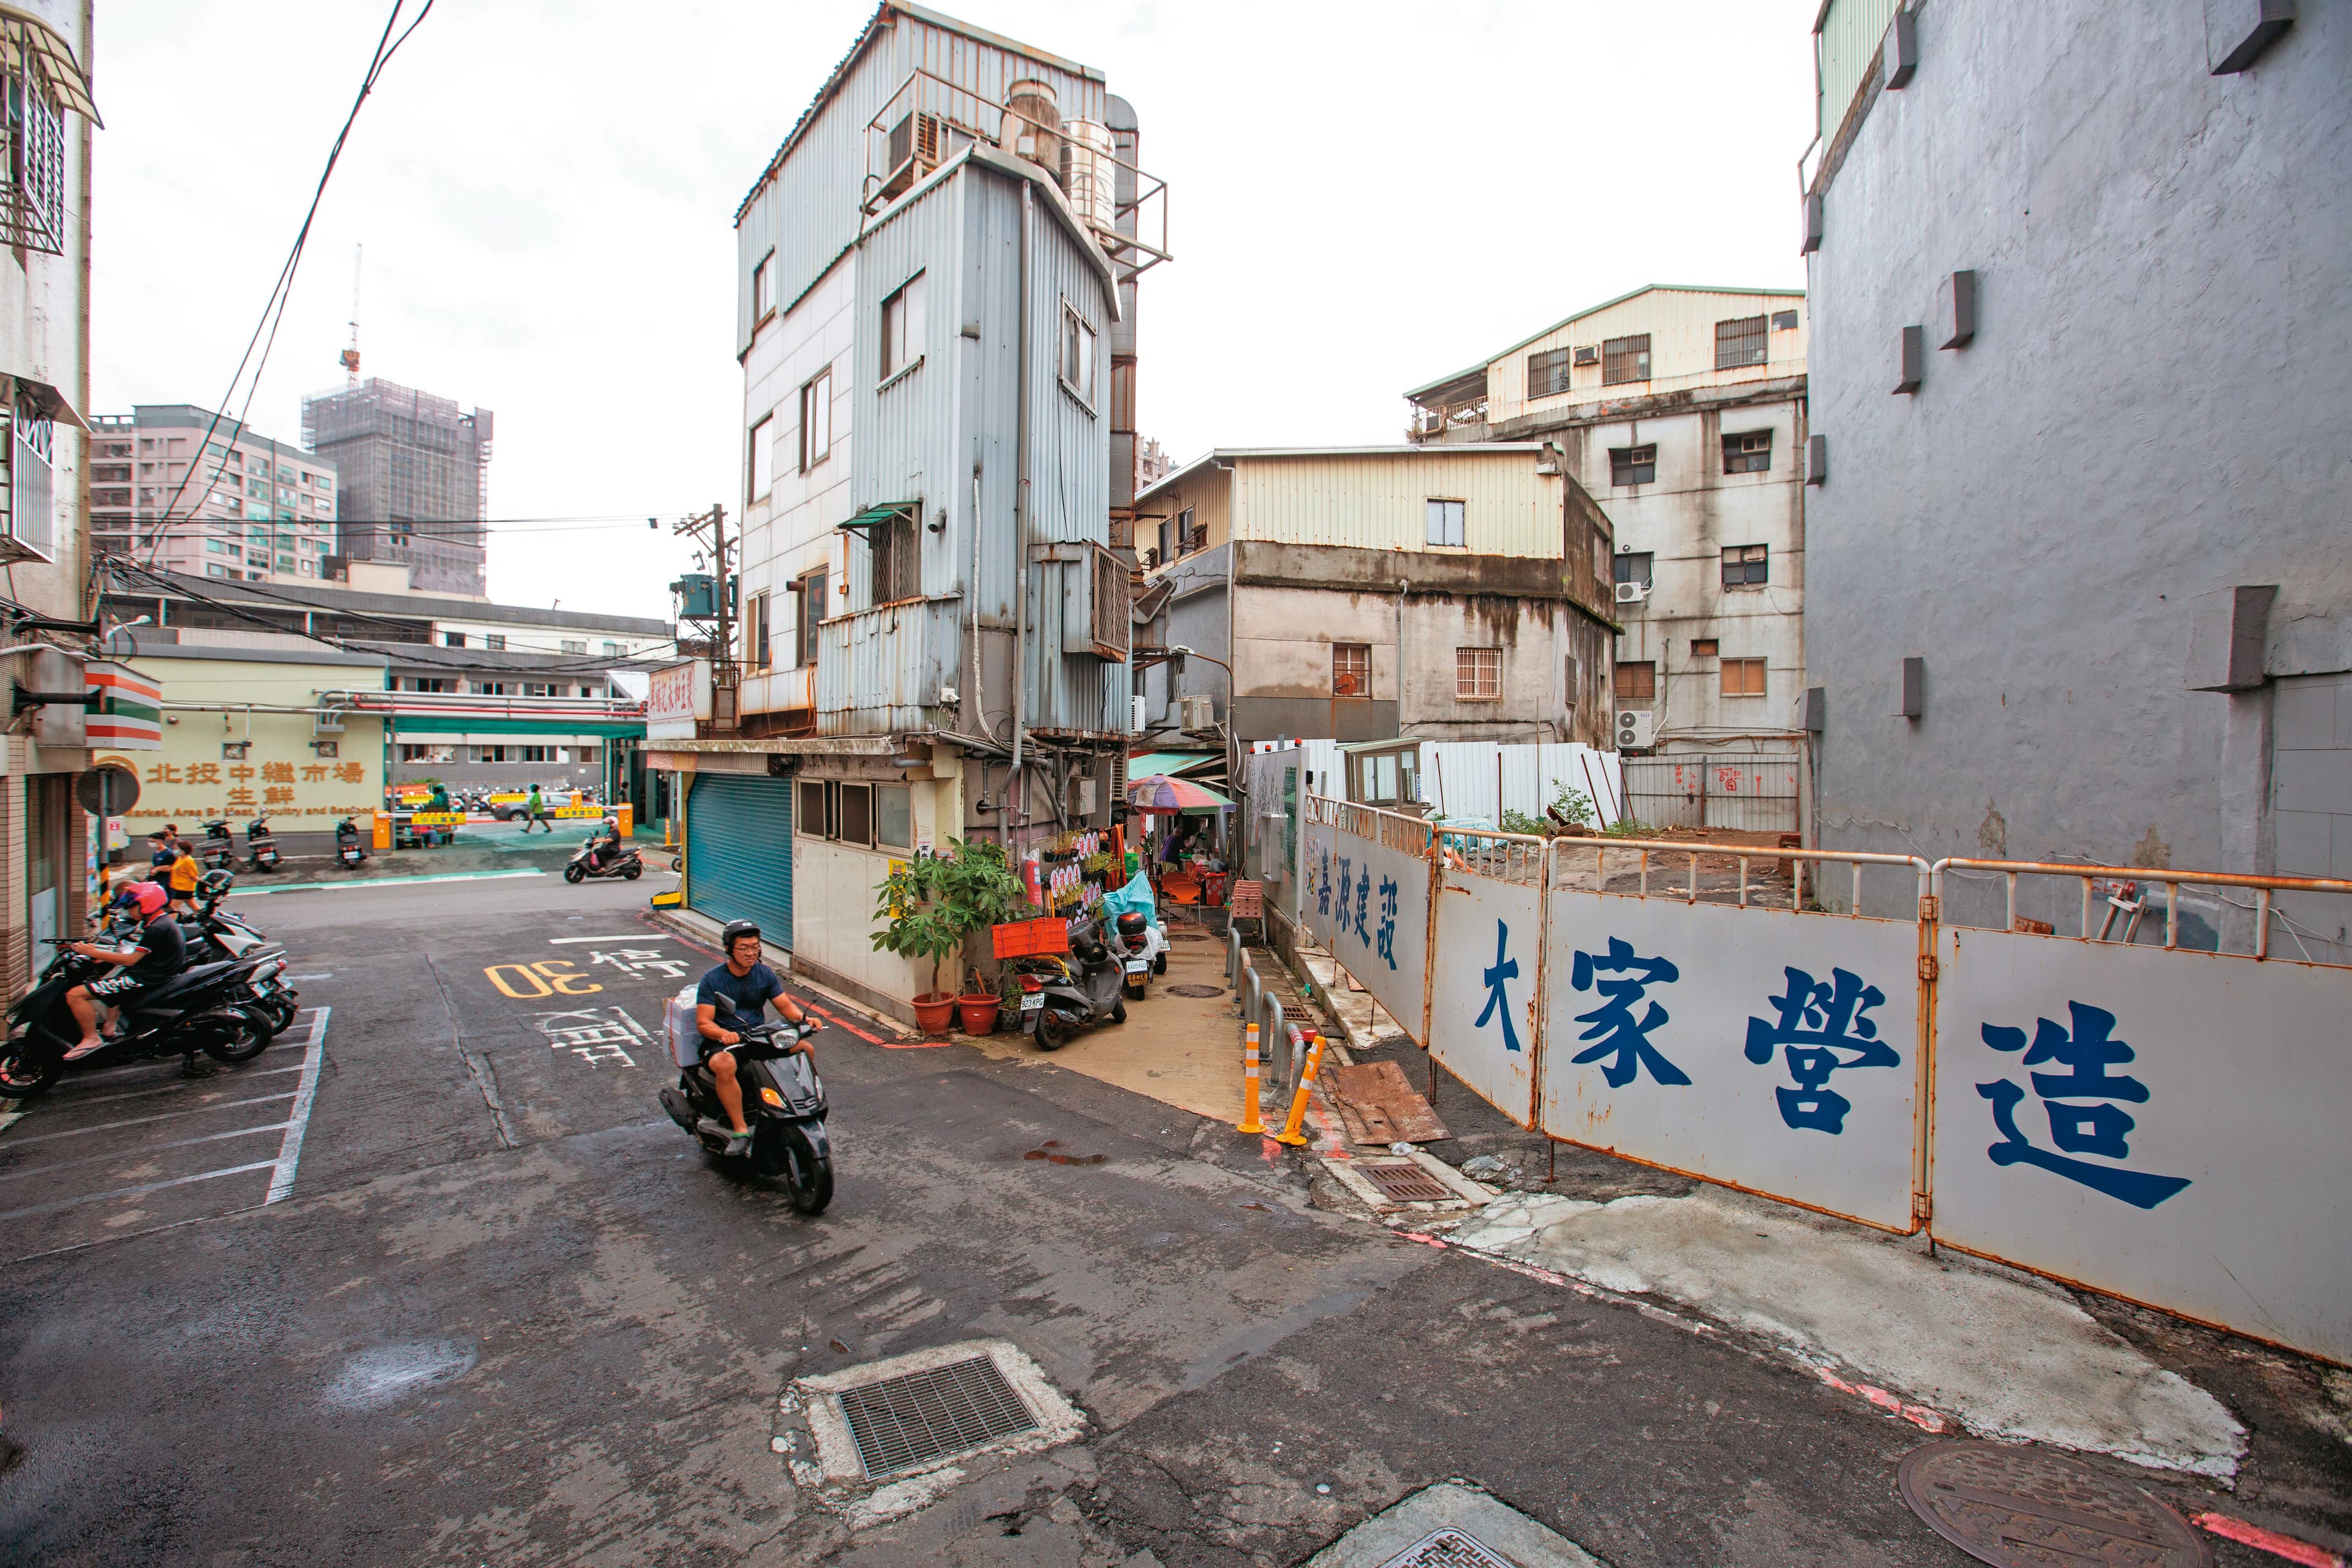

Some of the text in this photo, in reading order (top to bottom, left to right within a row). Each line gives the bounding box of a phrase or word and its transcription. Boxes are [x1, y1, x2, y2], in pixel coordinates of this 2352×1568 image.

[146, 761, 365, 784] 北投中繼市場
[227, 785, 295, 805] 生鮮
[173, 807, 203, 816] Area
[306, 806, 327, 815] and
[1317, 845, 1398, 970] 嘉源建設
[588, 949, 690, 980] 停
[483, 960, 603, 998] 30
[1021, 998, 1043, 1008] 923-KPG
[1474, 919, 2193, 1210] 大家營造
